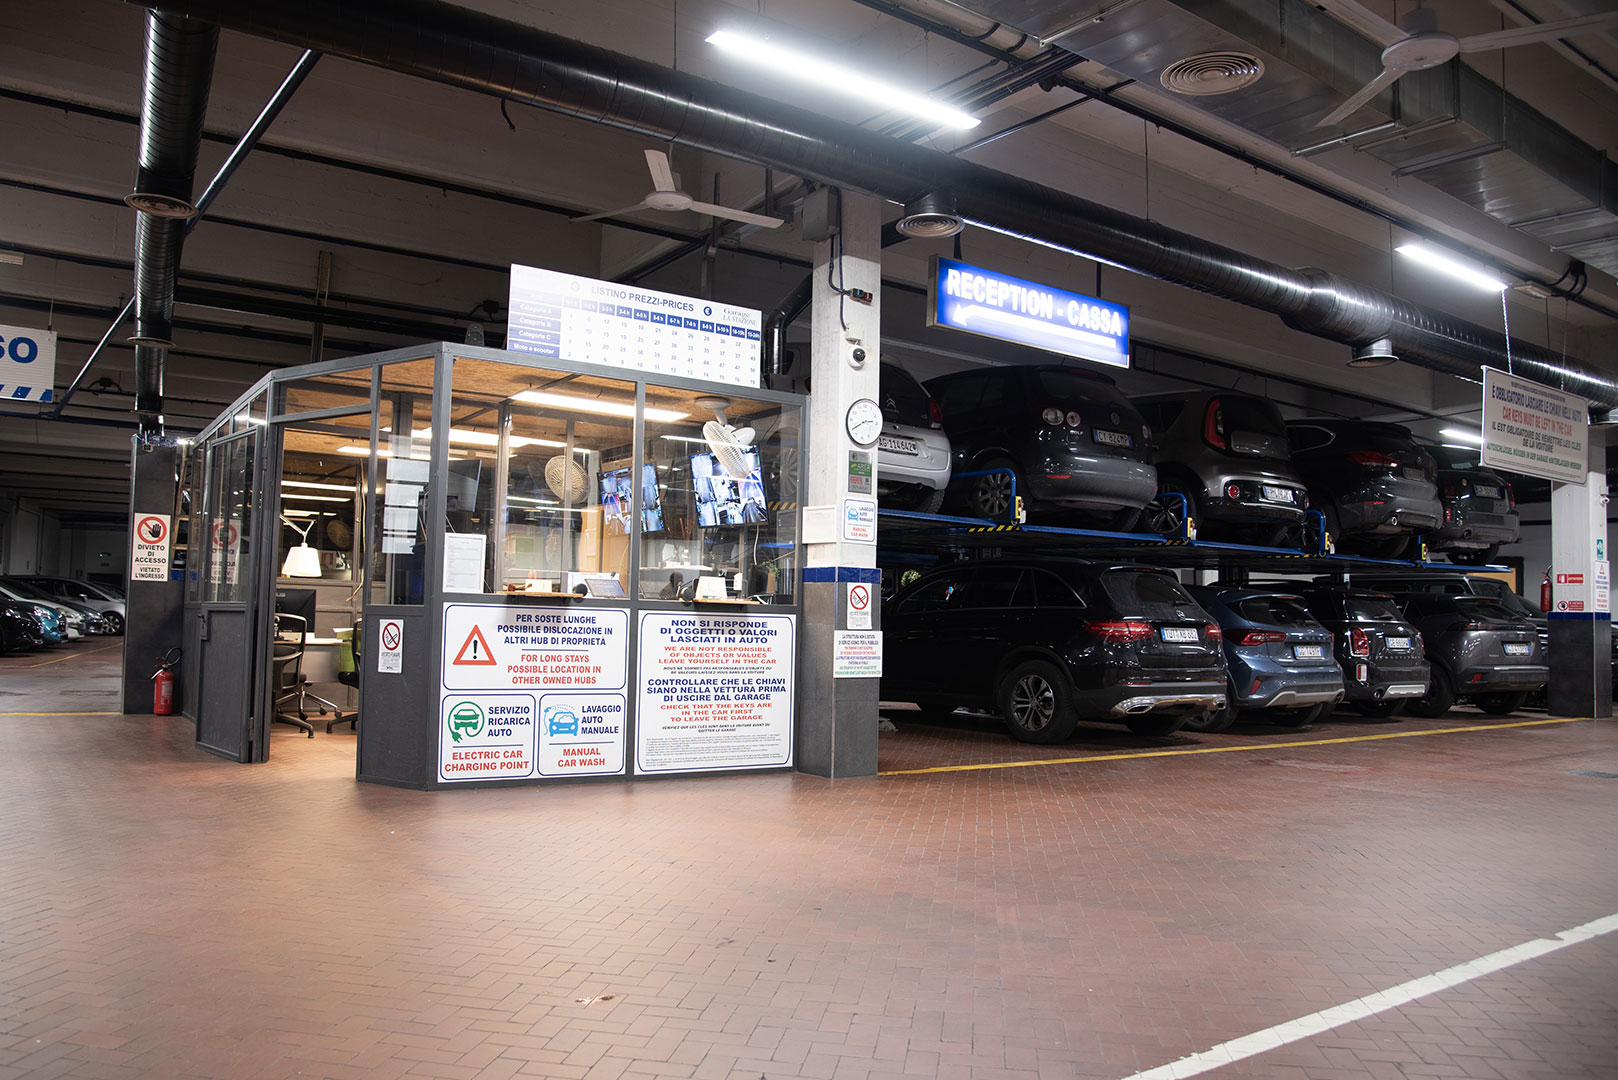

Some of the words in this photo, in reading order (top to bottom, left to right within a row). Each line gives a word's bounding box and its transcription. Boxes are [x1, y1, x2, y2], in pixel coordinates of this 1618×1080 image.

[591, 285, 626, 299] LISTINO
[628, 292, 694, 311] PREZZI-PRICES
[947, 269, 1052, 319] RECEPTION
[1068, 300, 1122, 336] CASSA
[723, 307, 750, 318] Garage
[731, 316, 756, 326] STAZIONE
[519, 330, 544, 339] Categoria
[0, 335, 38, 364] O
[1502, 406, 1511, 420] CAR
[1512, 409, 1522, 423] KEYS
[1523, 412, 1534, 426] MUST
[1535, 415, 1540, 428] BE
[1541, 417, 1549, 431] LEFT
[1564, 424, 1572, 437] CAR
[1492, 420, 1496, 429] IL
[1497, 422, 1506, 432] EST
[1506, 425, 1534, 439] OBLIGATOIRE
[1535, 432, 1540, 440] DE
[1541, 434, 1562, 446] REMETTRE
[1522, 438, 1528, 446] DE
[1535, 442, 1553, 453] VOITURE
[534, 615, 561, 623] SOSTE
[564, 616, 596, 624] LUNGHE
[498, 625, 541, 633] POSSIBILE
[544, 626, 602, 635] DISLOCAZIONE
[562, 636, 606, 646] PROPRIETÀ
[507, 665, 548, 673] POSSIBLE
[488, 706, 530, 714] SERVIZIO
[581, 716, 603, 724] AUTO
[581, 726, 619, 735] MANUALE
[452, 751, 500, 760] ELECTRIC
[503, 750, 523, 758] CAR
[563, 748, 601, 756] MANUAL
[445, 762, 497, 772] CHARGING
[500, 761, 529, 770] POINT
[558, 760, 576, 768] CAR
[579, 758, 605, 766] WASH
